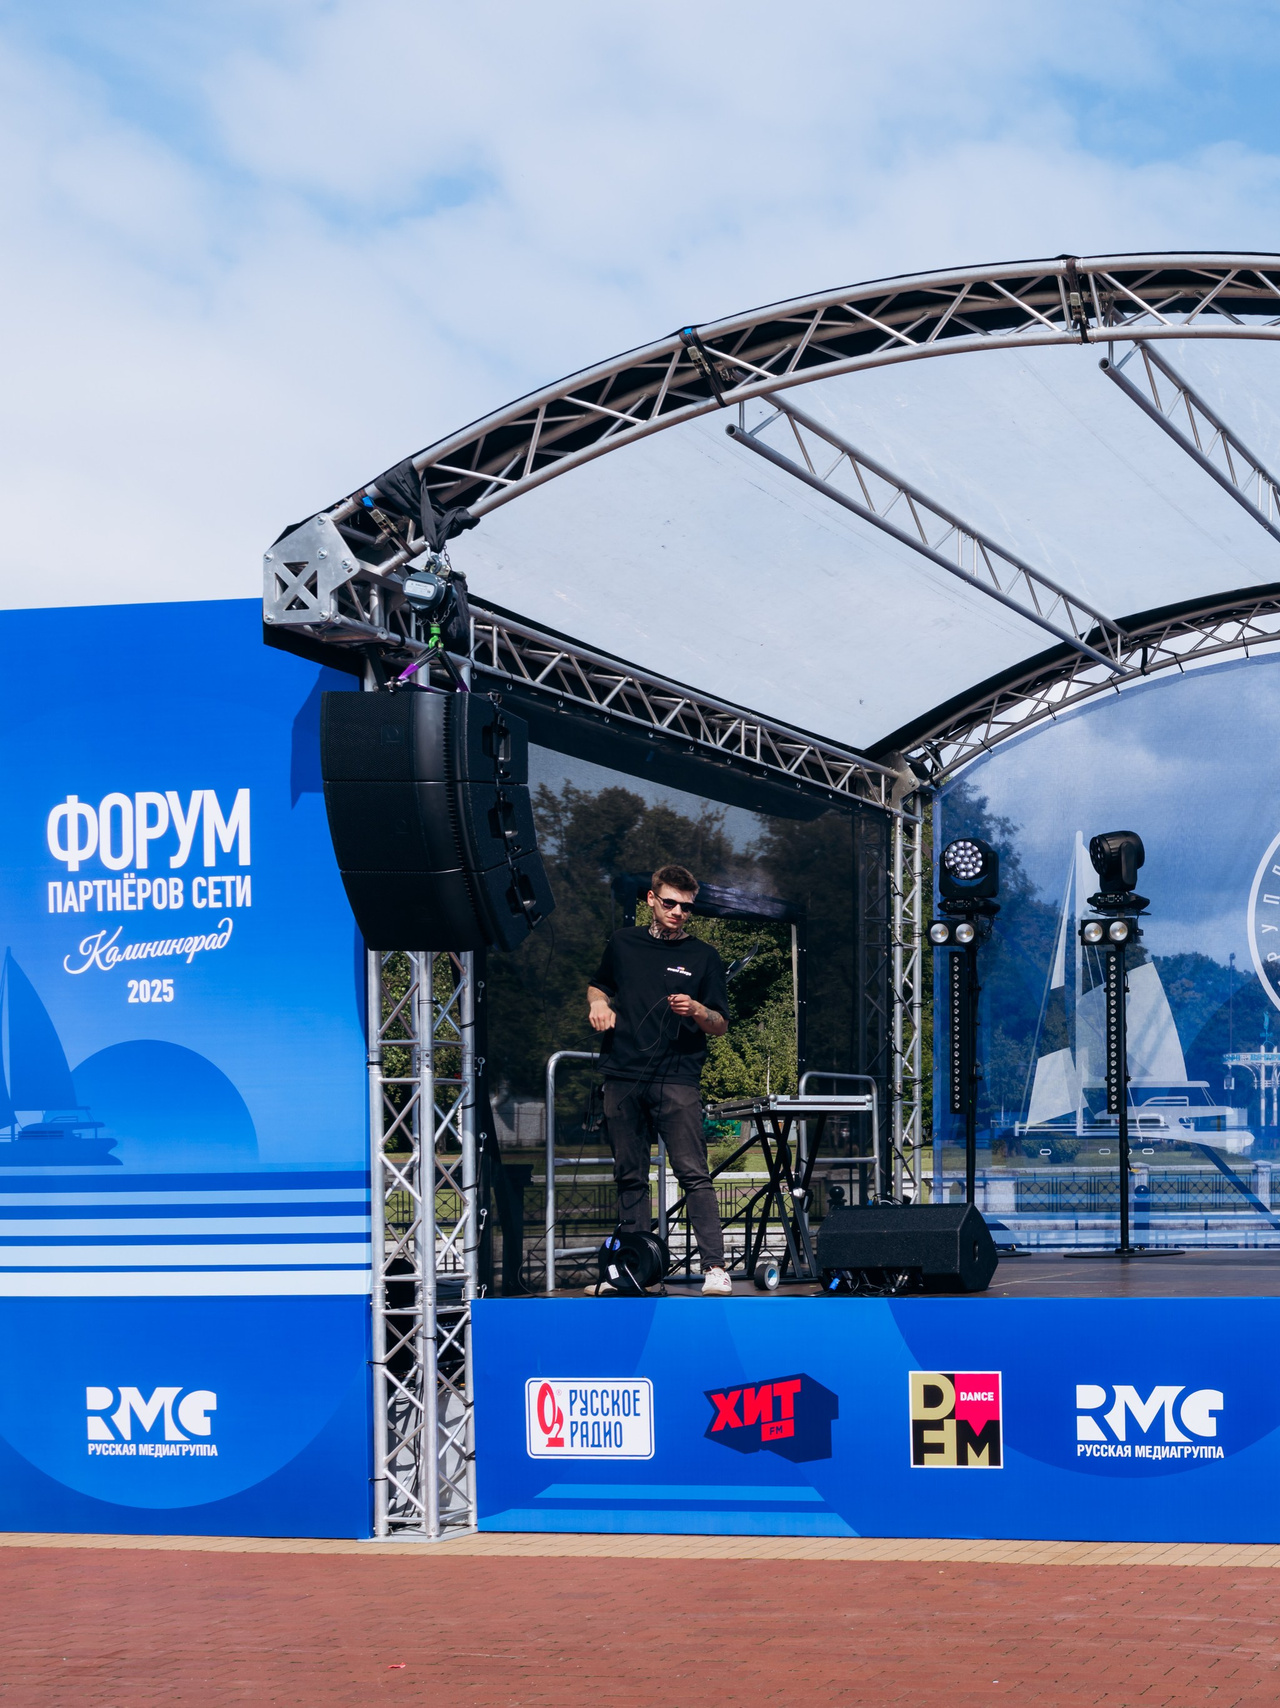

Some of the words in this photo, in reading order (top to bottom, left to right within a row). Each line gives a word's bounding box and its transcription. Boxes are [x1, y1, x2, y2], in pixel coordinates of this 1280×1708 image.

[47, 788, 251, 872] ФОРУМ
[48, 873, 184, 914] ПАРТНЁРОВ
[191, 875, 252, 909] СЕТИ
[63, 917, 234, 975] Калининград
[127, 979, 175, 1003] 2025
[569, 1389, 641, 1417] РУССКОЕ
[711, 1378, 801, 1433] ХИТ
[960, 1391, 995, 1402] DANCE
[86, 1387, 217, 1441] RMG
[1076, 1384, 1224, 1443] RMG
[569, 1420, 623, 1449] РАДИО
[769, 1426, 783, 1436] FM
[88, 1443, 137, 1456] РУССКАЯ
[138, 1443, 218, 1458] МЕДИАГРУППА
[1077, 1444, 1132, 1459] РУССКАЯ
[1134, 1445, 1225, 1460] МЕДИАГРУППА
